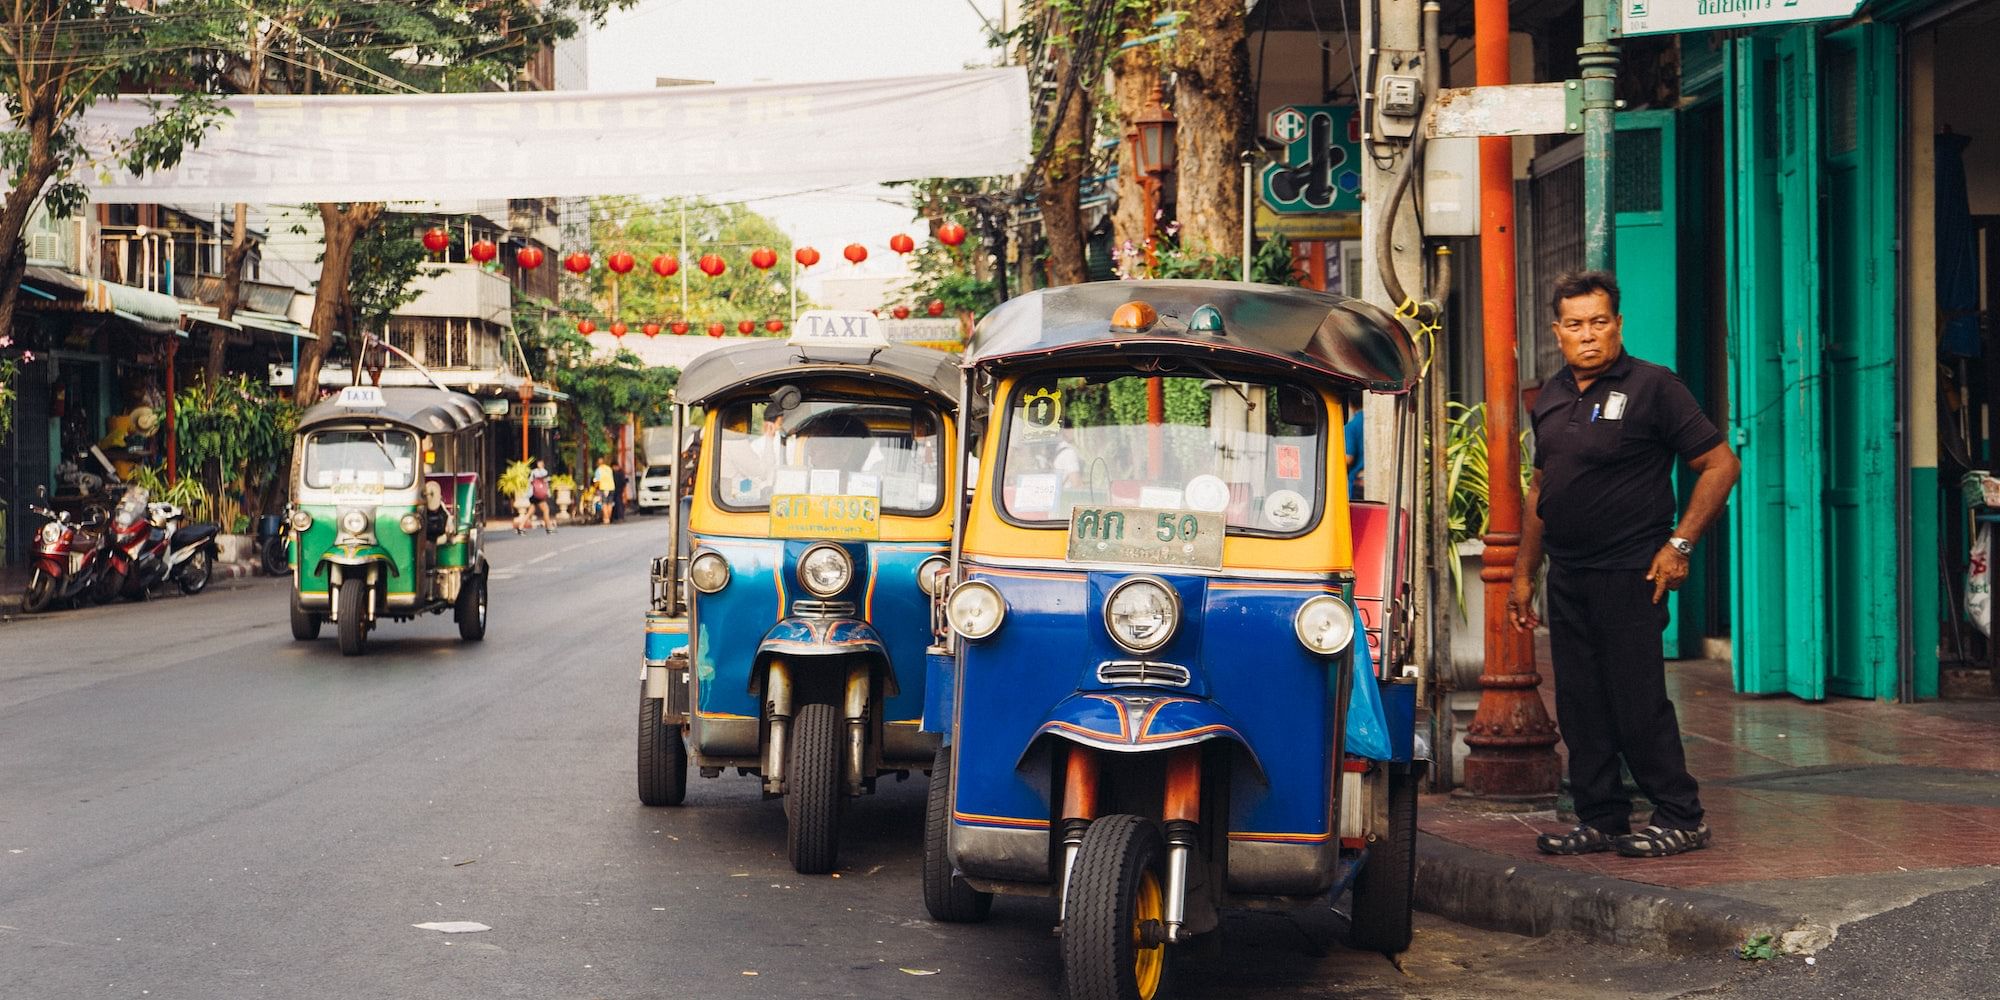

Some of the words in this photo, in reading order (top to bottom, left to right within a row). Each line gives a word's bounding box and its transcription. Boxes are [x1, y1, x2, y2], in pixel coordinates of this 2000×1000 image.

[808, 315, 869, 338] TAXI
[347, 390, 375, 401] TAXI
[1156, 512, 1199, 543] 50
